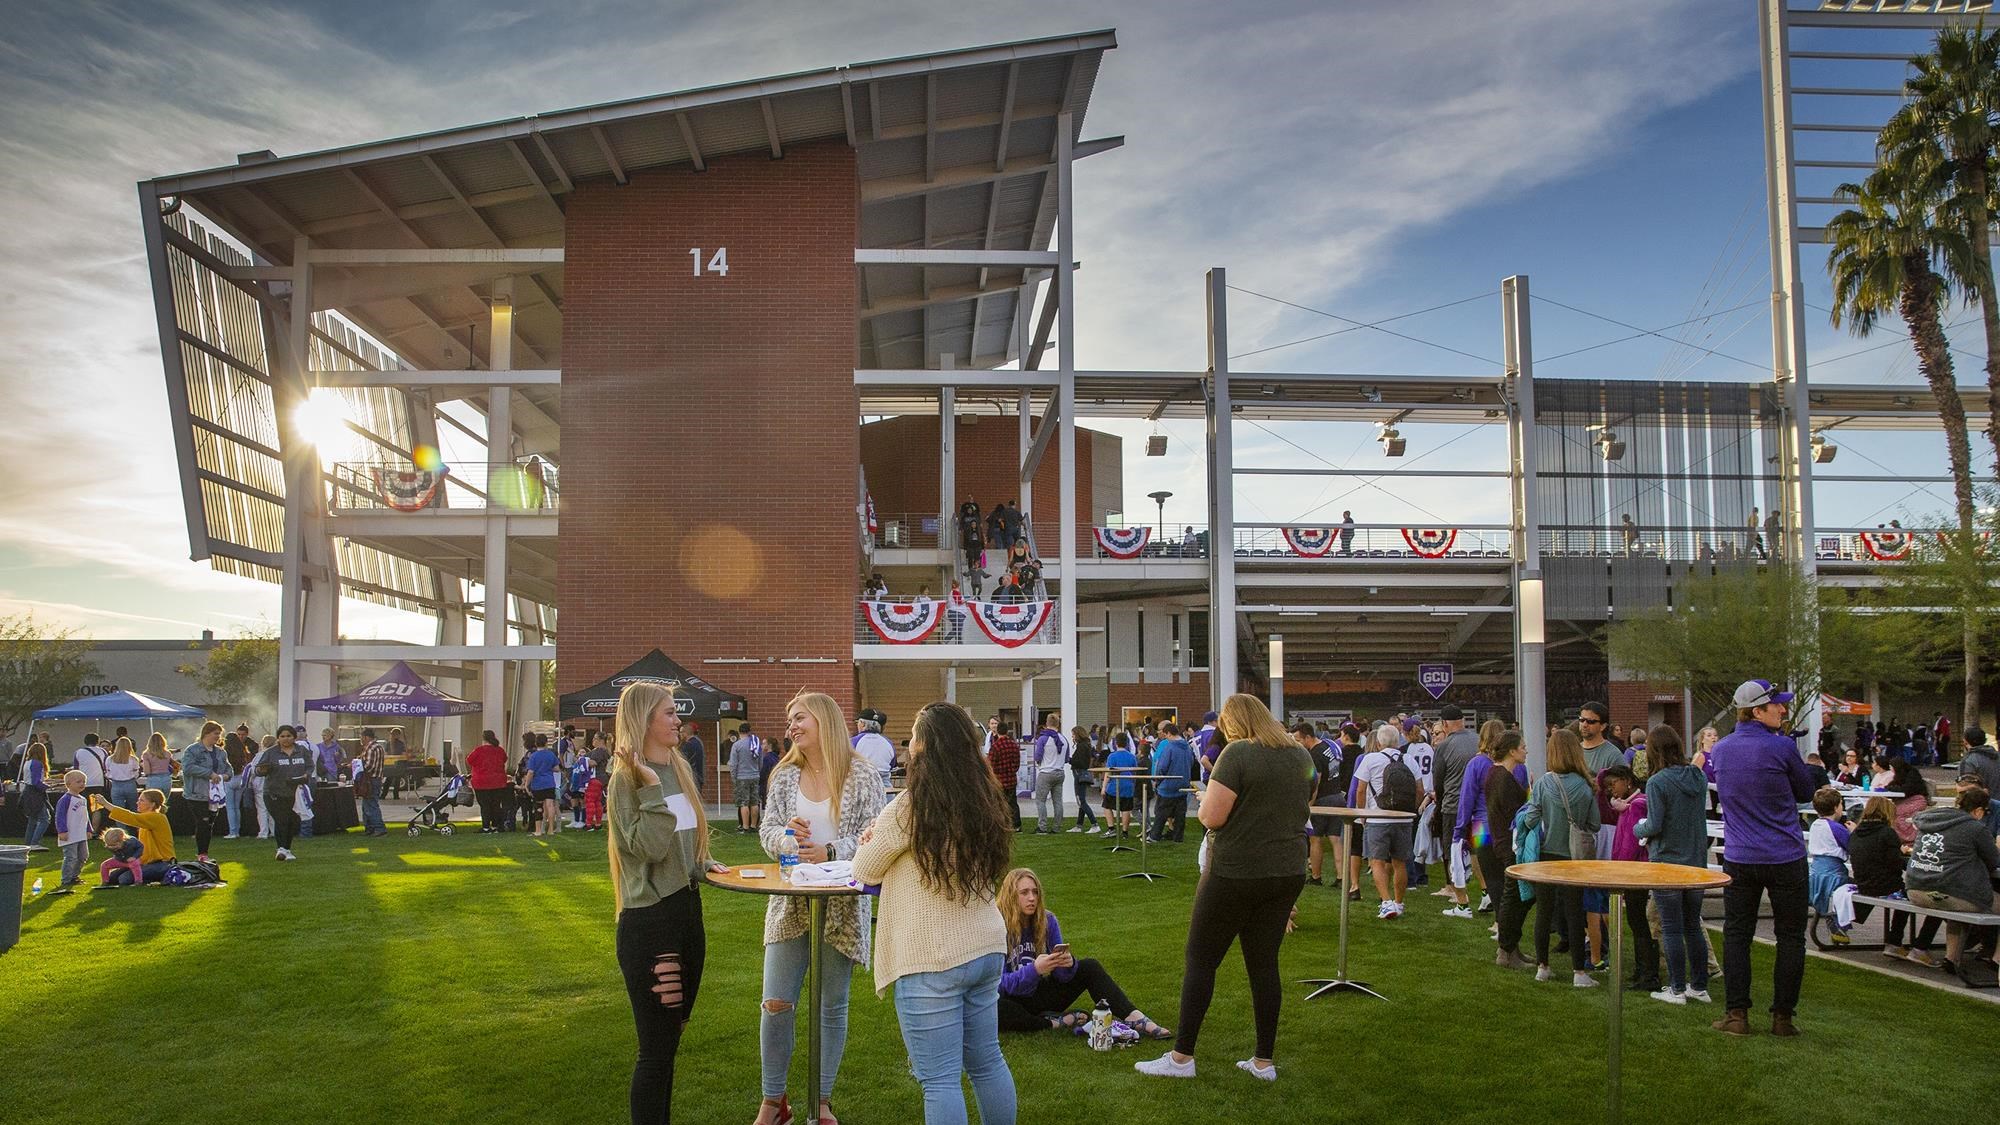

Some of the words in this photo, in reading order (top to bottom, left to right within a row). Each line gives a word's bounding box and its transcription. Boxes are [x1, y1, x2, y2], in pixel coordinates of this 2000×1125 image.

[689, 247, 729, 277] 14
[1423, 671, 1449, 683] GCU
[359, 682, 416, 697] GCU
[1910, 859, 1945, 872] Disneyland
